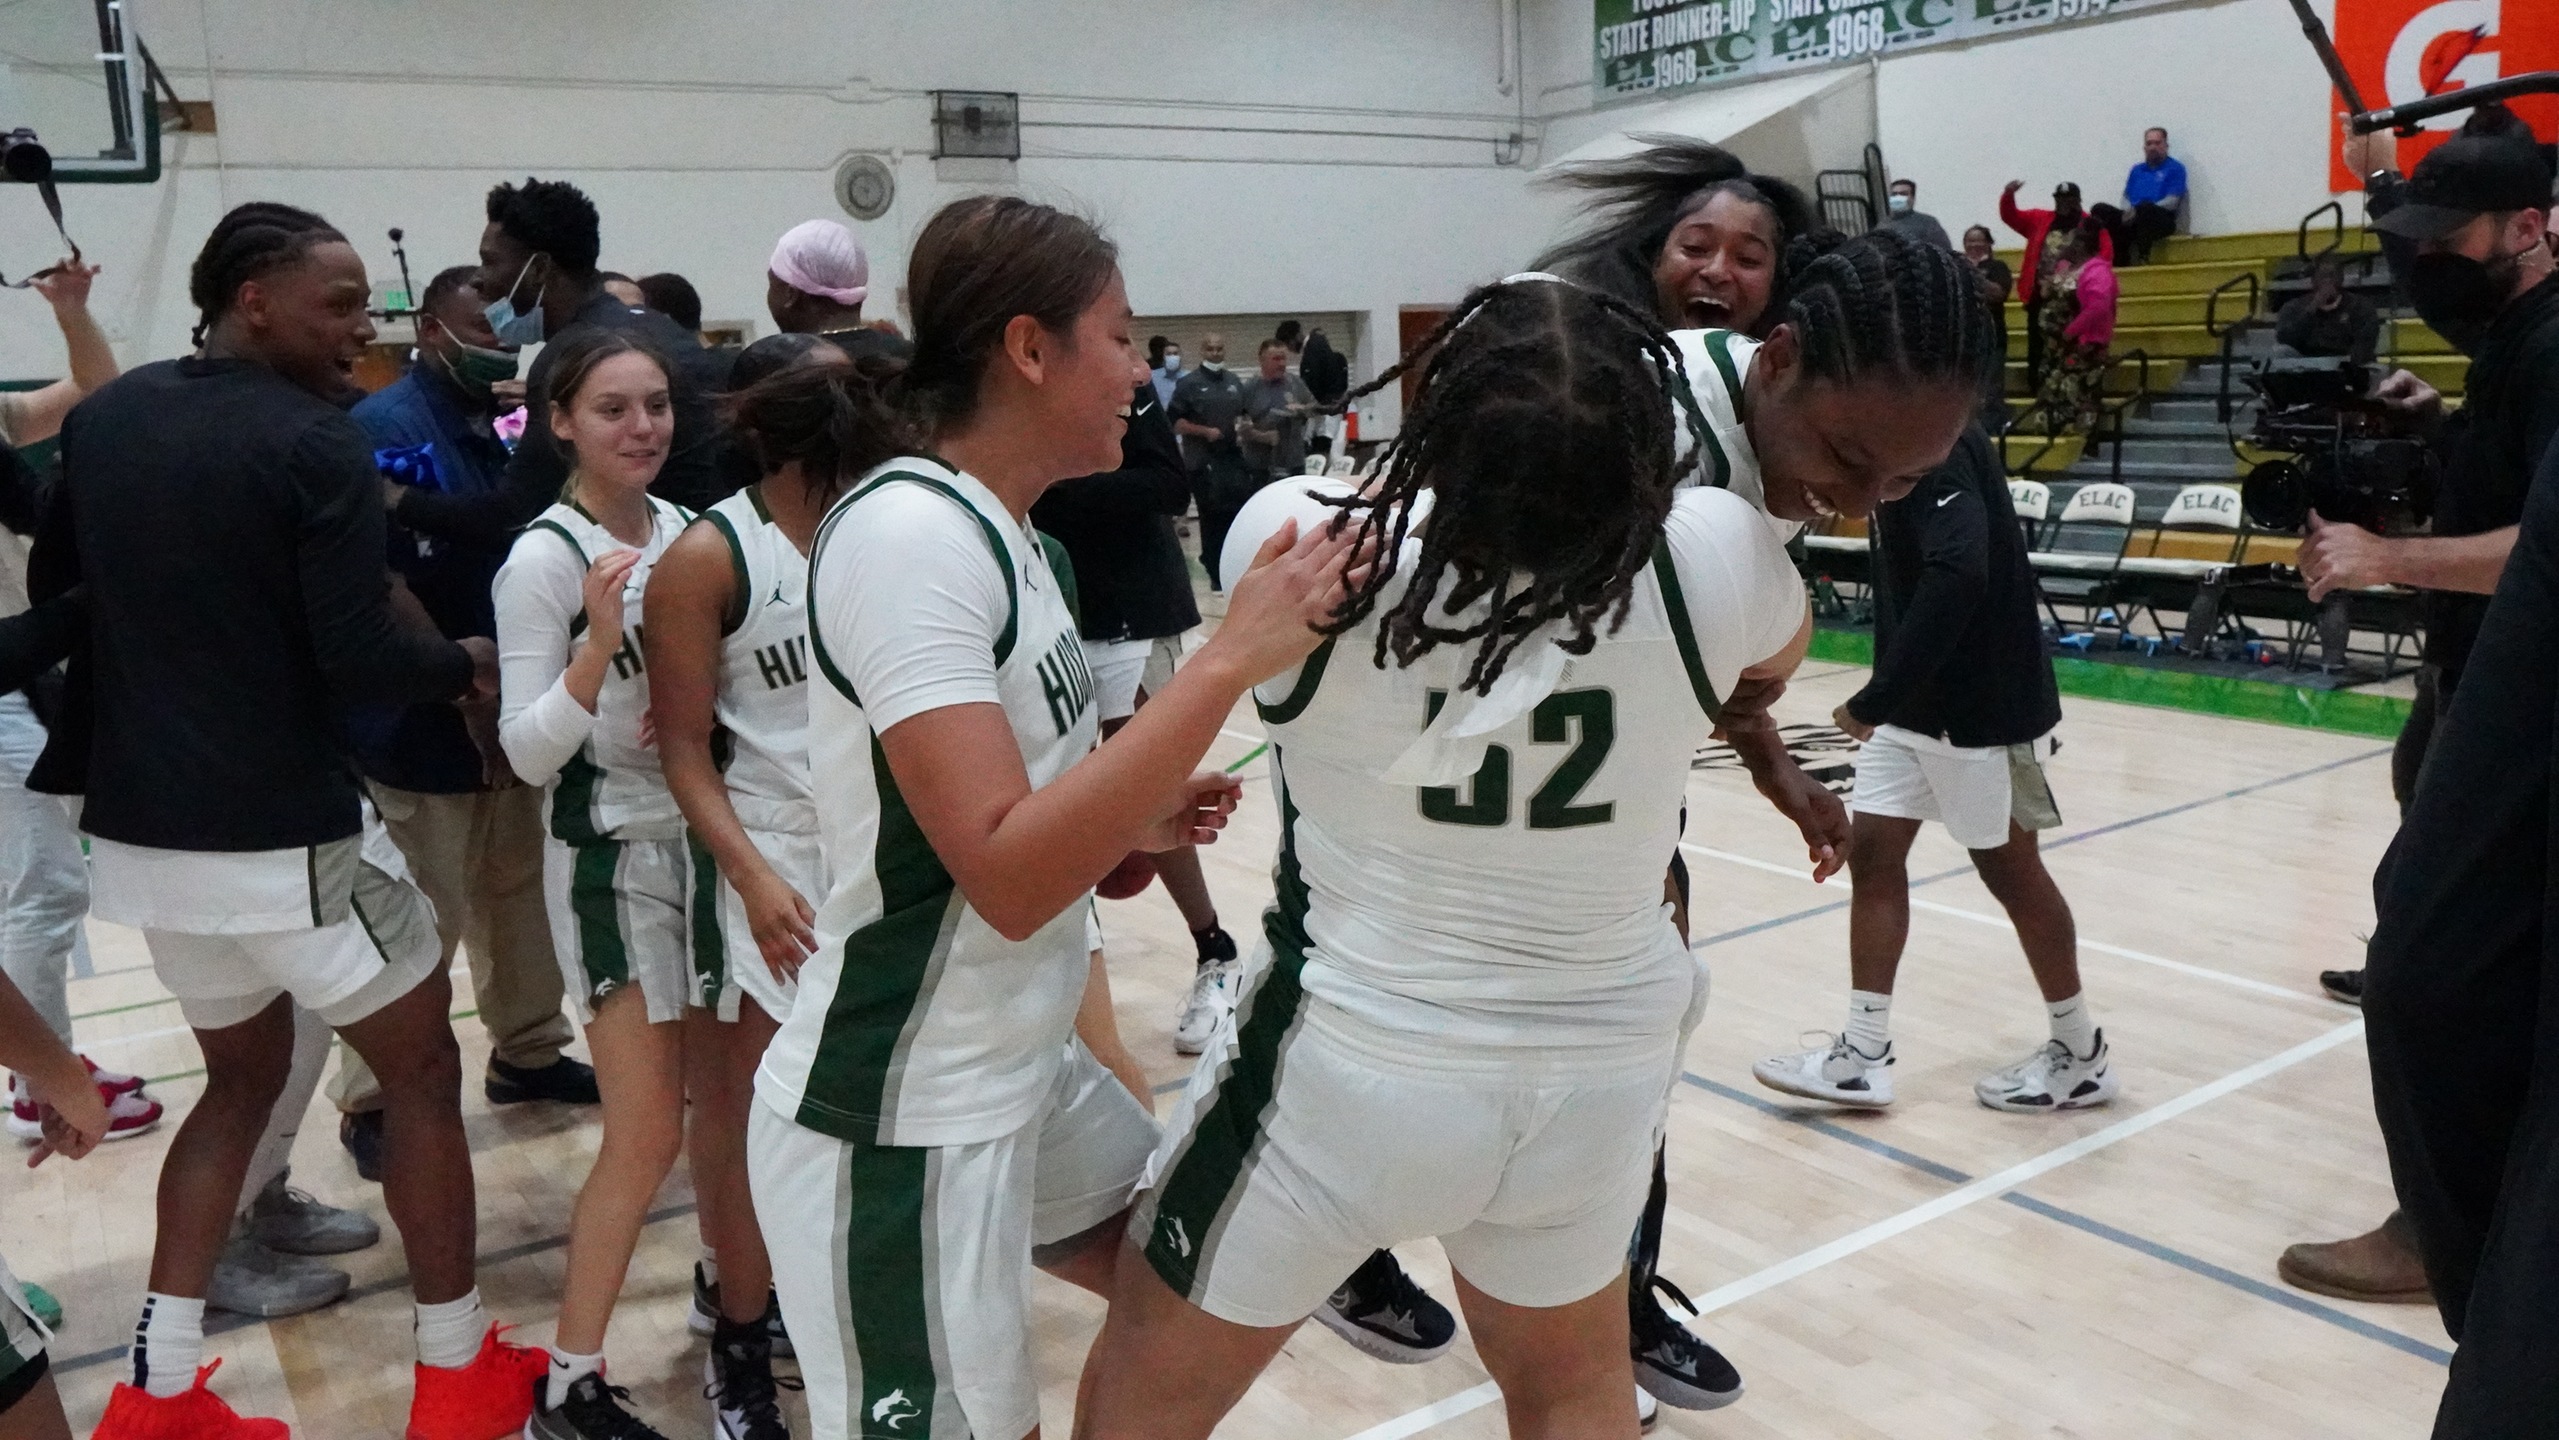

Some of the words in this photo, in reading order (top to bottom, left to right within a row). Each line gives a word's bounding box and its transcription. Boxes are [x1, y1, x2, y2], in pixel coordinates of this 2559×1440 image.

[1600, 18, 1649, 59] STATE
[1652, 0, 1756, 49] RUNNER-UP
[1826, 6, 1885, 58] 1968
[1652, 48, 1697, 92] 1968
[2079, 490, 2127, 509] ELAC
[2182, 493, 2235, 513] ELAC
